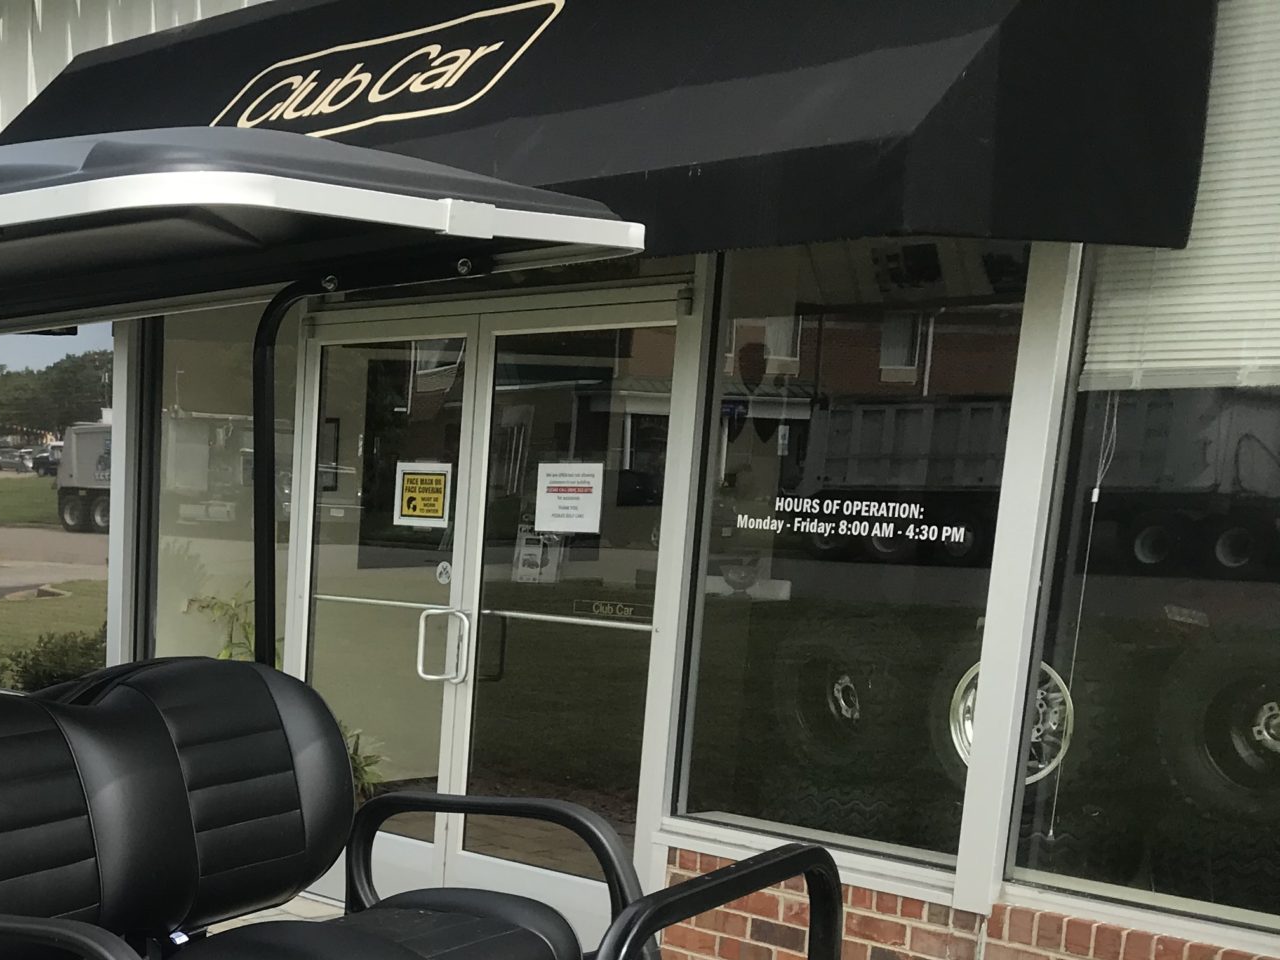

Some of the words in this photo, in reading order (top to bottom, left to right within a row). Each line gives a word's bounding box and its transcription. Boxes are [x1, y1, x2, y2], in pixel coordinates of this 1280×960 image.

[237, 63, 372, 128] Club
[367, 41, 505, 103] Car
[775, 497, 821, 514] HOURS
[823, 499, 842, 515] OF
[843, 500, 924, 519] OPERATION:
[736, 514, 785, 534] Monday
[793, 517, 836, 537] Friday:
[838, 519, 869, 537] 8:00
[871, 522, 895, 538] AM
[905, 523, 939, 541] 4:30
[941, 526, 966, 543] PM
[593, 602, 614, 614] Club
[616, 603, 634, 615] Car
